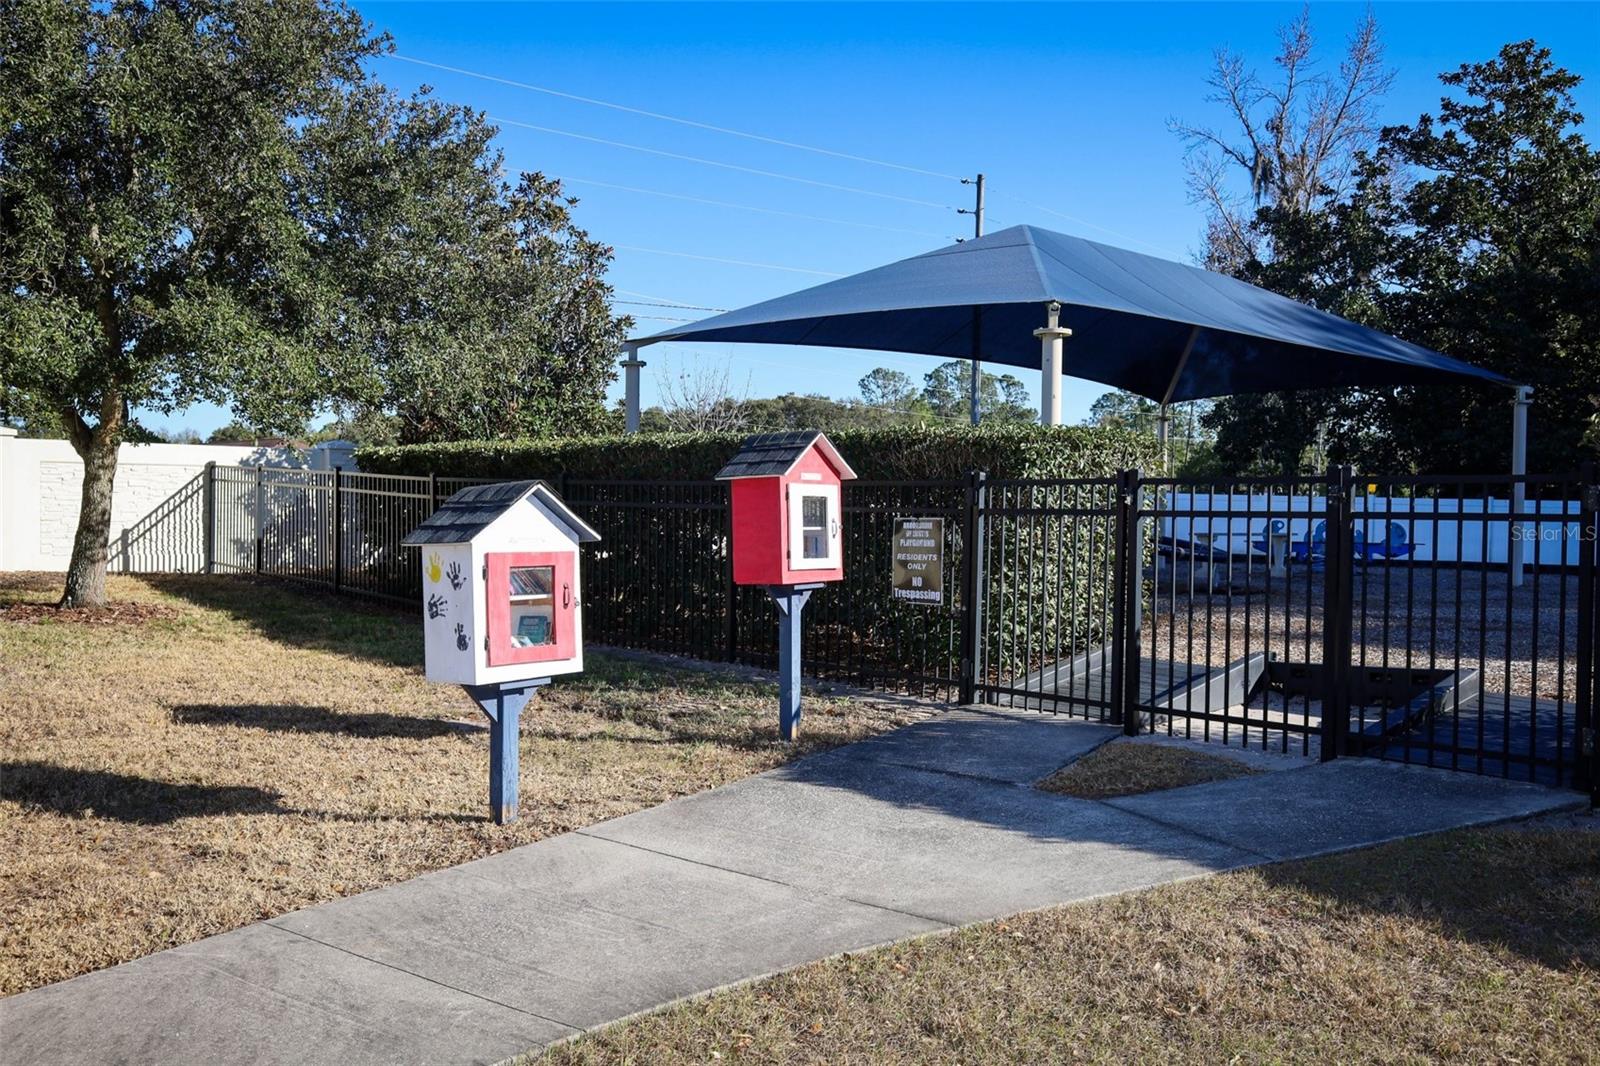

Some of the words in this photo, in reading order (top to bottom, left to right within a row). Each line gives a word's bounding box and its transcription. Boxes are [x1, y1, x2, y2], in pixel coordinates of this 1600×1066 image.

[897, 553, 937, 561] RESIDENTS
[907, 562, 927, 570] ONLY
[911, 576, 923, 587] NO
[894, 588, 940, 601] Trespassing
